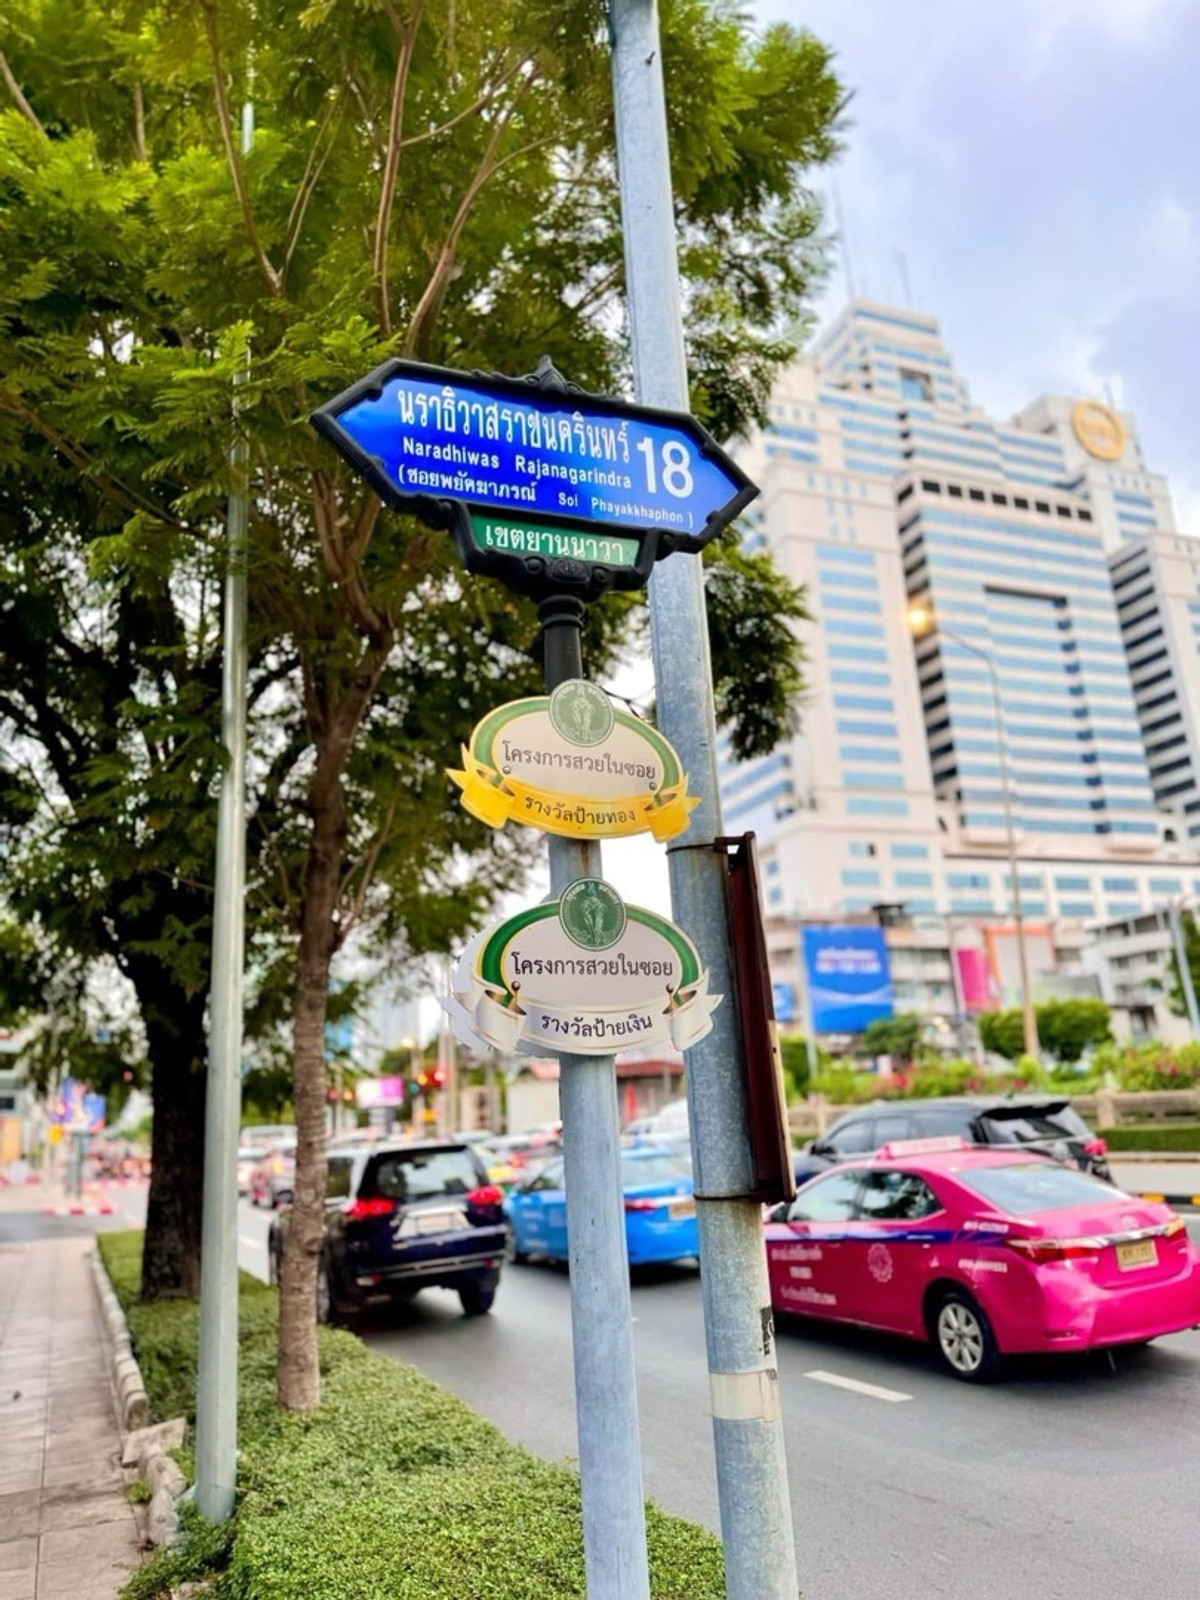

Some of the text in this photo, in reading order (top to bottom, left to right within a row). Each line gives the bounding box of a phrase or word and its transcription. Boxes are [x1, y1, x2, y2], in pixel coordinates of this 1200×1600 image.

[398, 386, 694, 498] นราธิวาสราชนครินทร์ 18
[403, 436, 632, 489] Naradhiwas Rajanagarindra
[558, 492, 578, 507] Soi
[485, 525, 624, 563] เขตยานนาวา
[502, 740, 656, 780] โครงการสวยในซอย
[525, 796, 636, 825] รางวัลป้ายทอง
[511, 951, 673, 976] โครงการสวยในซอย
[541, 1012, 653, 1038] รางวัลป้ายเงิน
